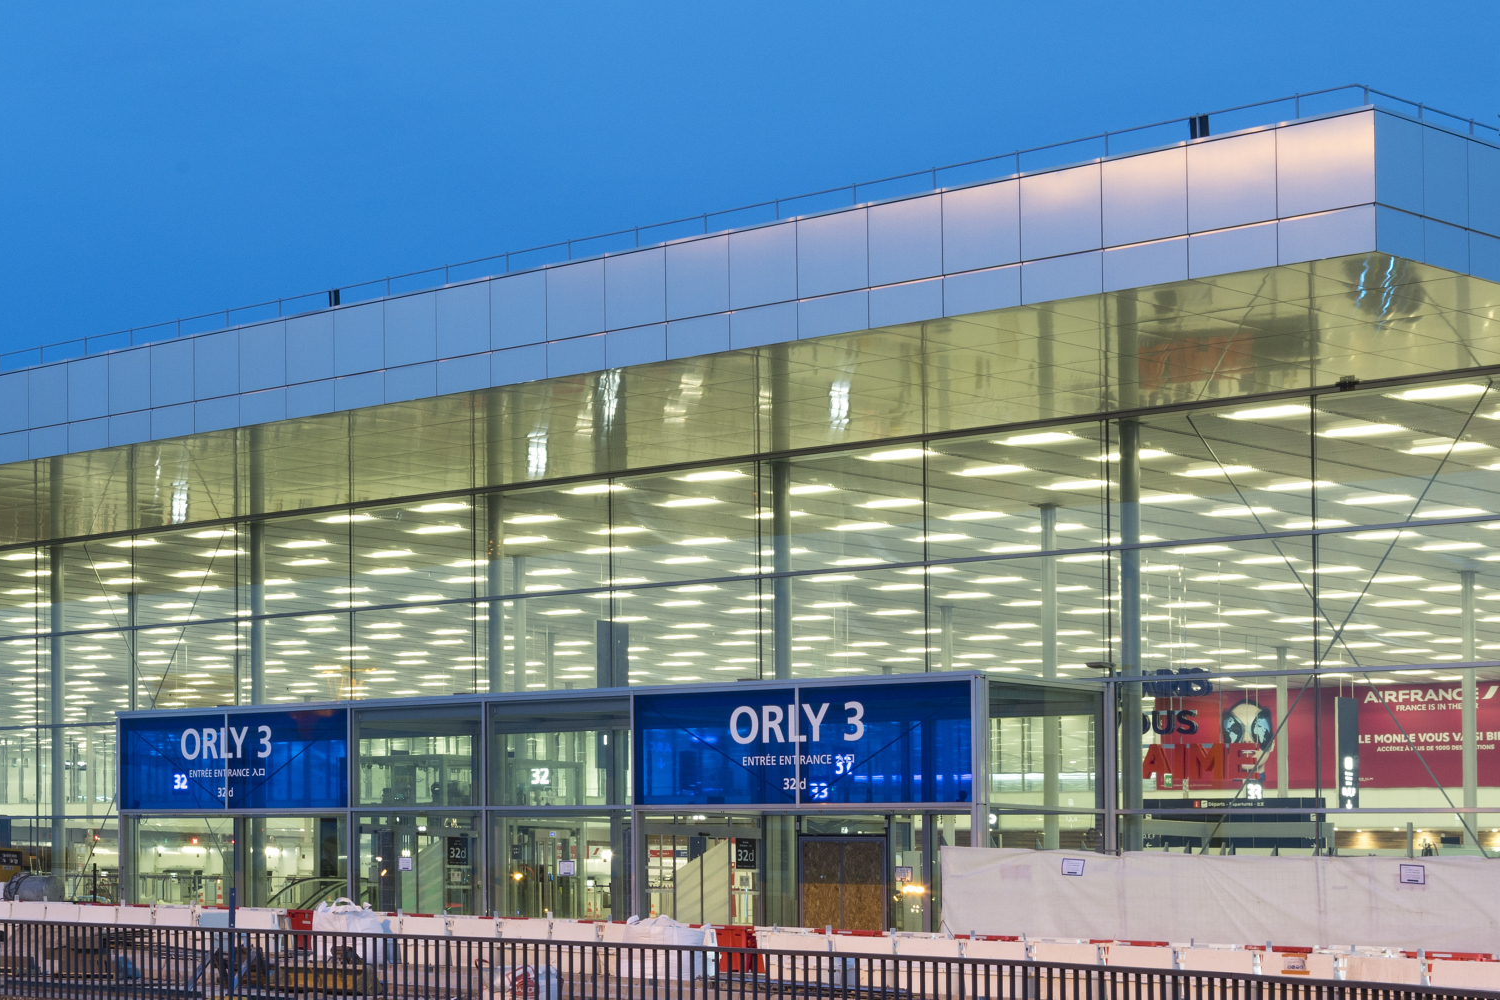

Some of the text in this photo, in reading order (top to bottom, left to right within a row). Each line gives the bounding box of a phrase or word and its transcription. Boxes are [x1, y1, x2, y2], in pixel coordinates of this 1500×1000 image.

[1364, 687, 1479, 703] AIRFRANC
[1395, 703, 1426, 711] FRANCE
[729, 701, 865, 745] ORLY 3
[180, 725, 272, 760] ORLY 3
[1358, 734, 1371, 743] LE
[1374, 733, 1415, 743] MONDE
[1418, 732, 1450, 742] VOUS
[1377, 744, 1404, 752] ACCÉDEZ
[1404, 744, 1410, 752] À
[742, 753, 832, 766] ENTRÉE ENTRANCE
[1143, 743, 1260, 779] AIME
[189, 768, 250, 778] ENTRÉE ENTRANCE
[251, 768, 265, 777] 入口
[530, 767, 550, 785] 32
[173, 773, 188, 790] 32
[449, 847, 467, 859] 32d
[737, 849, 754, 862] 32d
